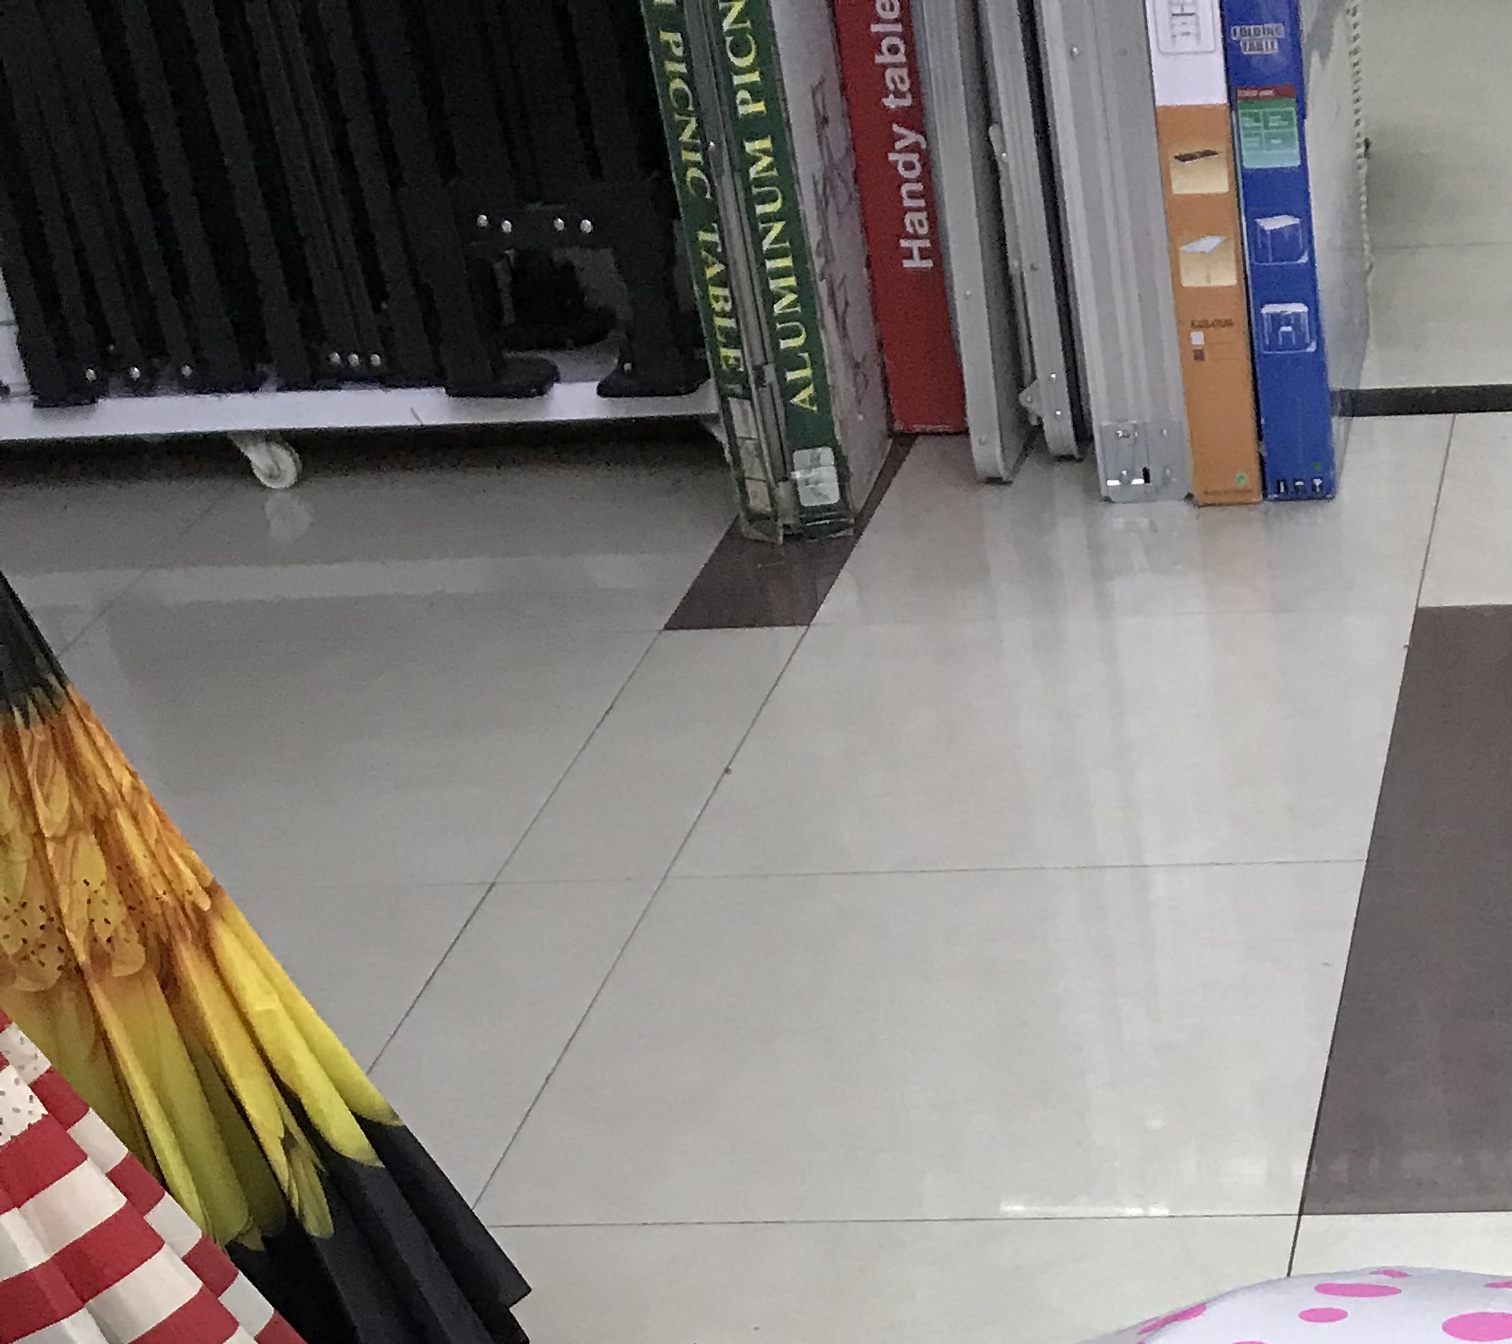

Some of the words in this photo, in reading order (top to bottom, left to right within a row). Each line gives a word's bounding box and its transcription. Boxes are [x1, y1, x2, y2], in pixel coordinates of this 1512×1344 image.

[870, 0, 912, 109] table
[659, 28, 713, 200] PICNIC
[697, 222, 744, 373] TABLE
[743, 134, 818, 412] ALUMINUM
[888, 123, 933, 270] Handy
